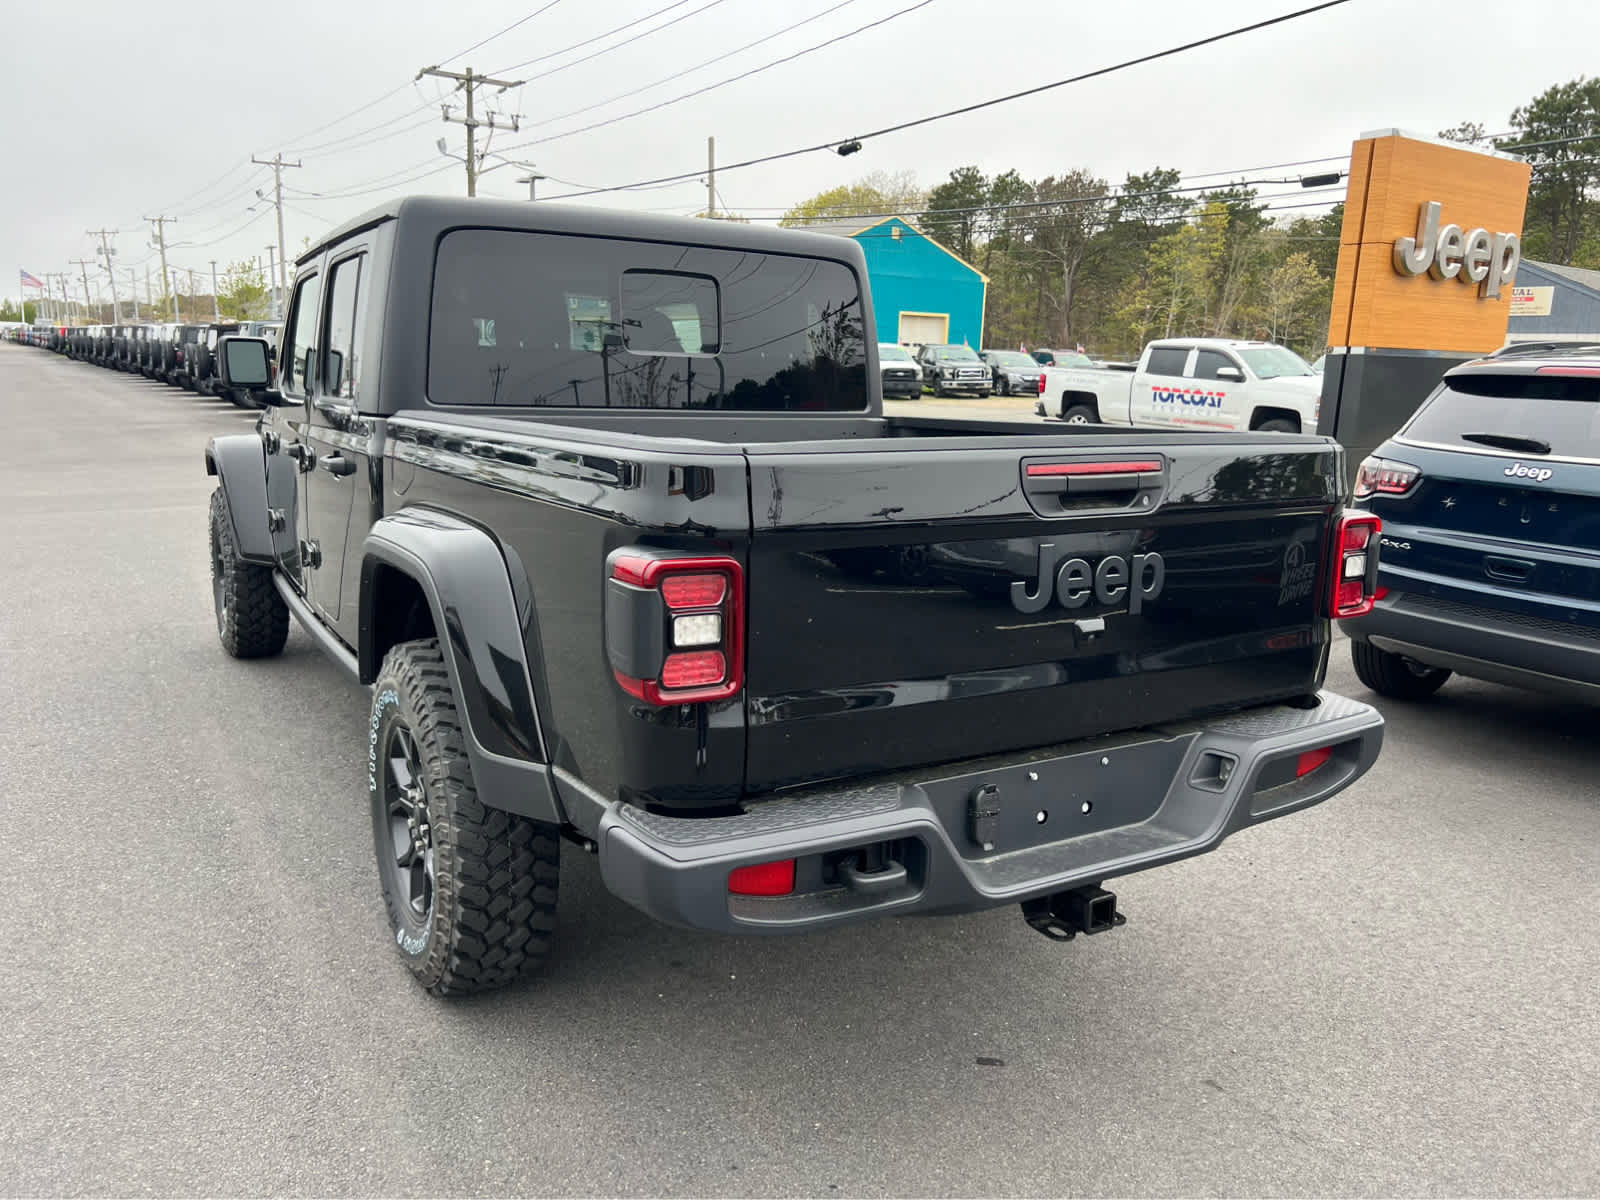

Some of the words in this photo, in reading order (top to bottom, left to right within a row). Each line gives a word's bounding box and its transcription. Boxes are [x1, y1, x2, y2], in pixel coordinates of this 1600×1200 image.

[1393, 201, 1520, 298] Jeep
[1152, 386, 1226, 408] TOPCOAT
[1504, 463, 1553, 482] Jeep
[1011, 543, 1165, 615] Jeep
